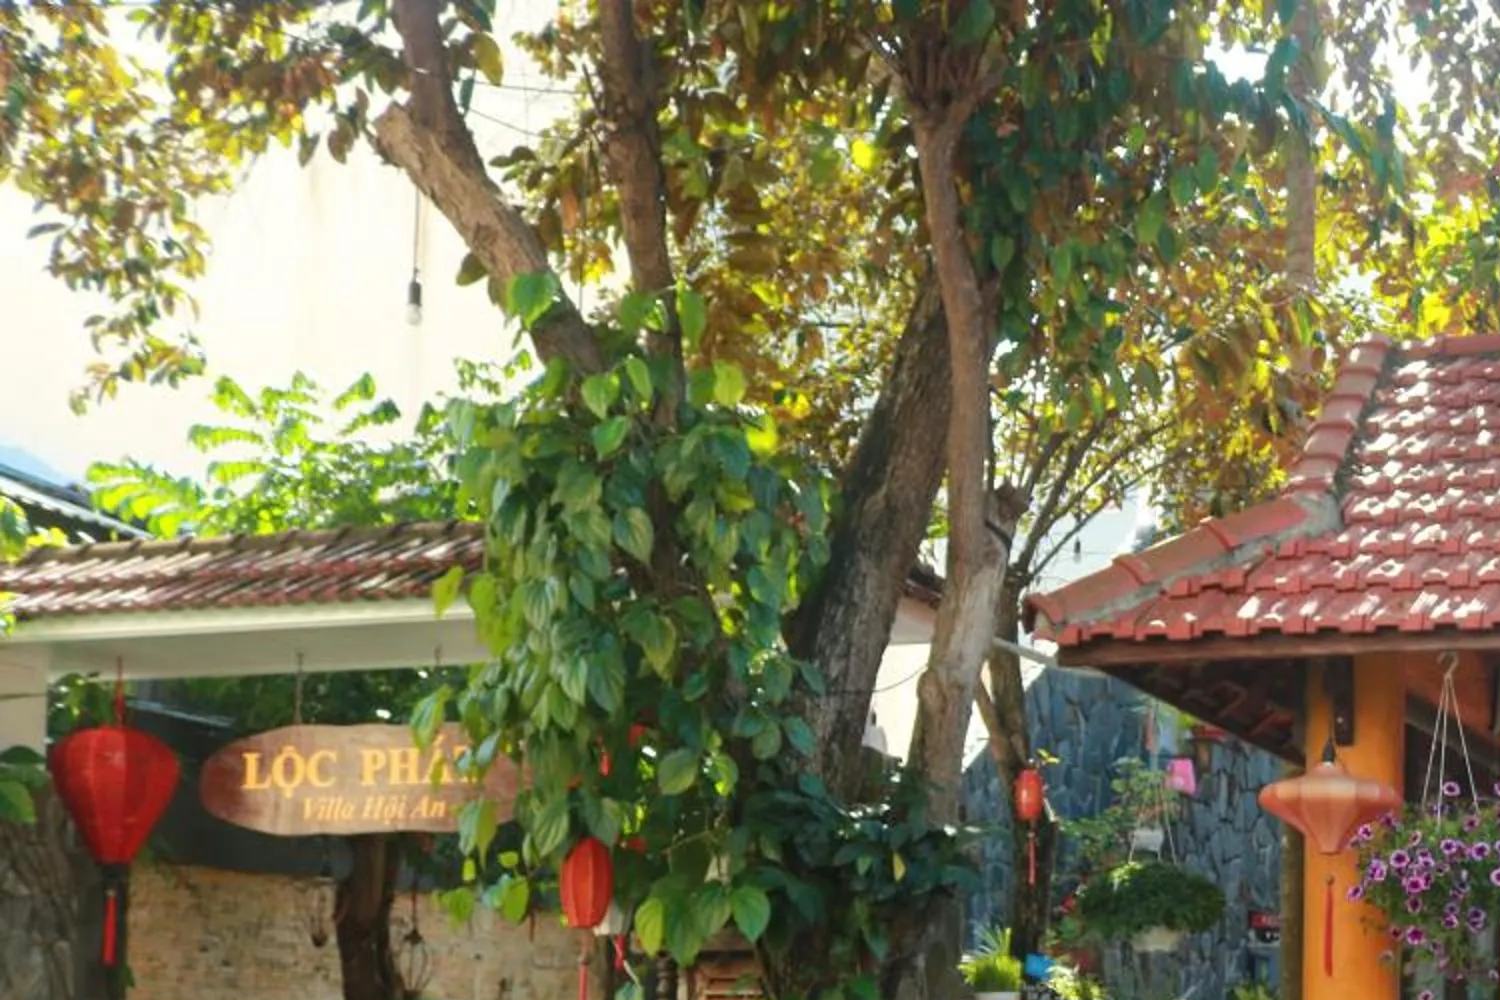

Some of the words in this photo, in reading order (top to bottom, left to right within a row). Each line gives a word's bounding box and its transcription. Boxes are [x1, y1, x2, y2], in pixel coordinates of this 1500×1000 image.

[241, 745, 337, 798] LỘC
[303, 797, 353, 821] Villa
[410, 795, 446, 818] An
